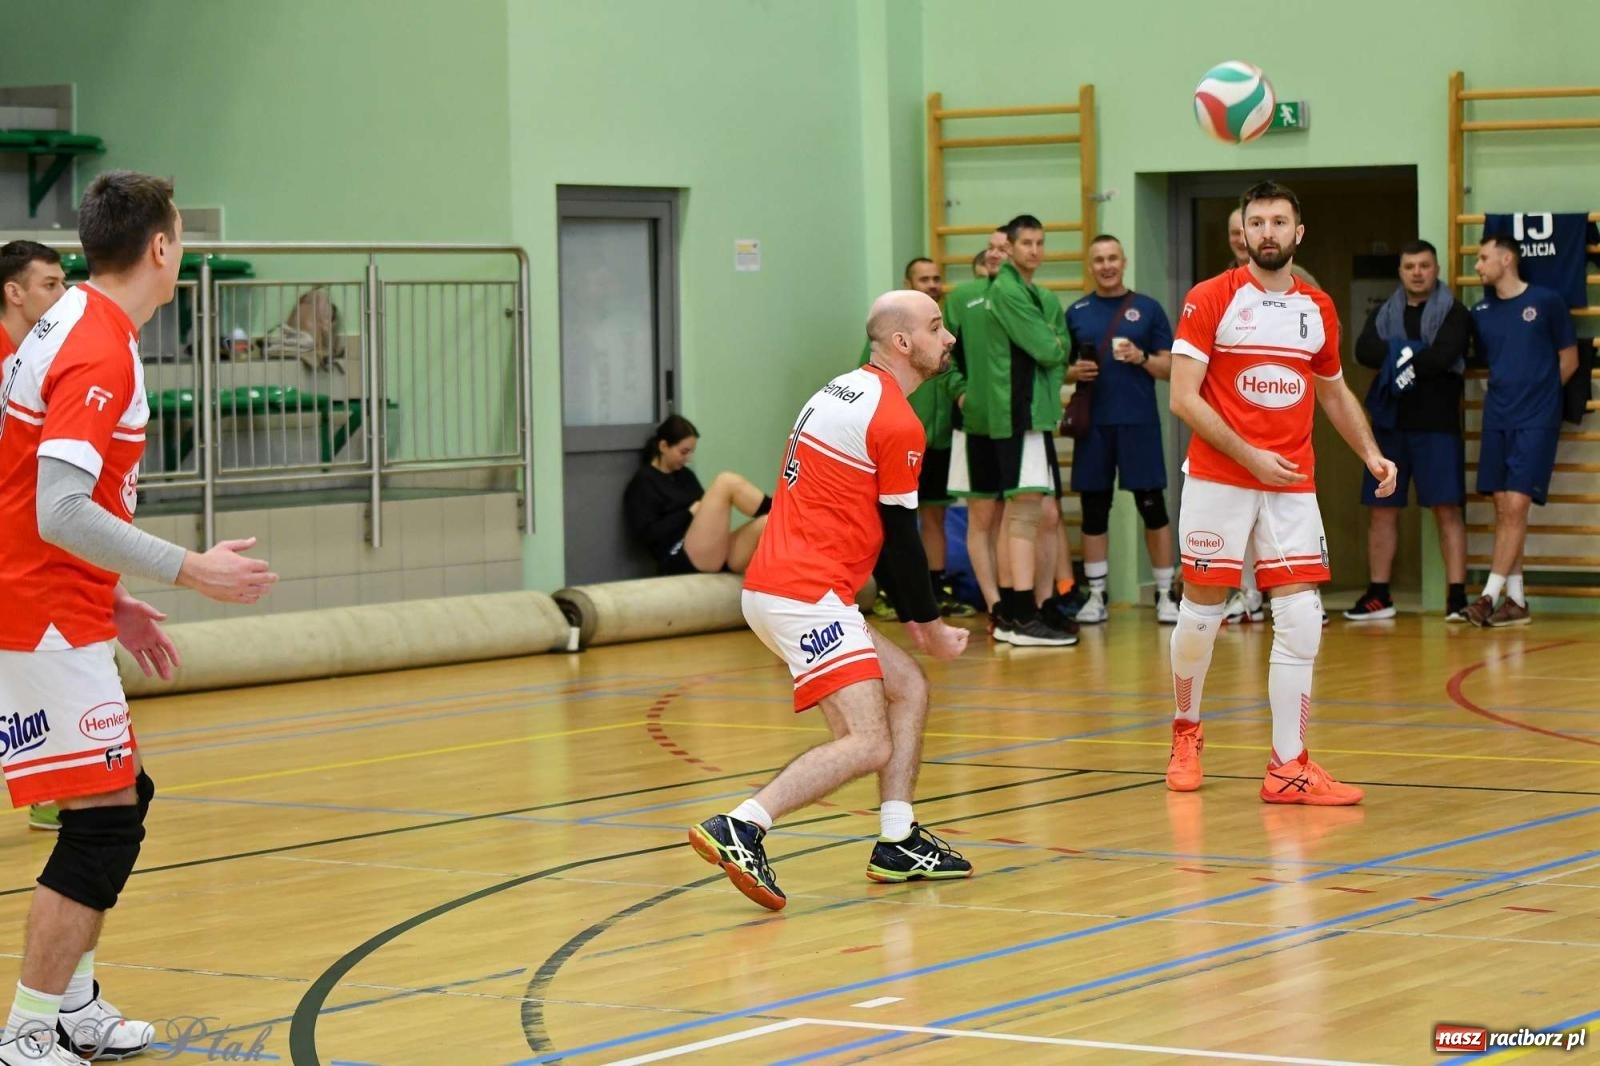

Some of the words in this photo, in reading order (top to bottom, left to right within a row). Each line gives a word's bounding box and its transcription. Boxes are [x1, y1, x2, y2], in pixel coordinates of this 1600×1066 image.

[1520, 242, 1556, 257] OLICJA
[824, 384, 865, 404] enkel
[1242, 375, 1301, 395] Henkel
[1188, 538, 1221, 548] Henkel
[800, 621, 845, 664] Silan
